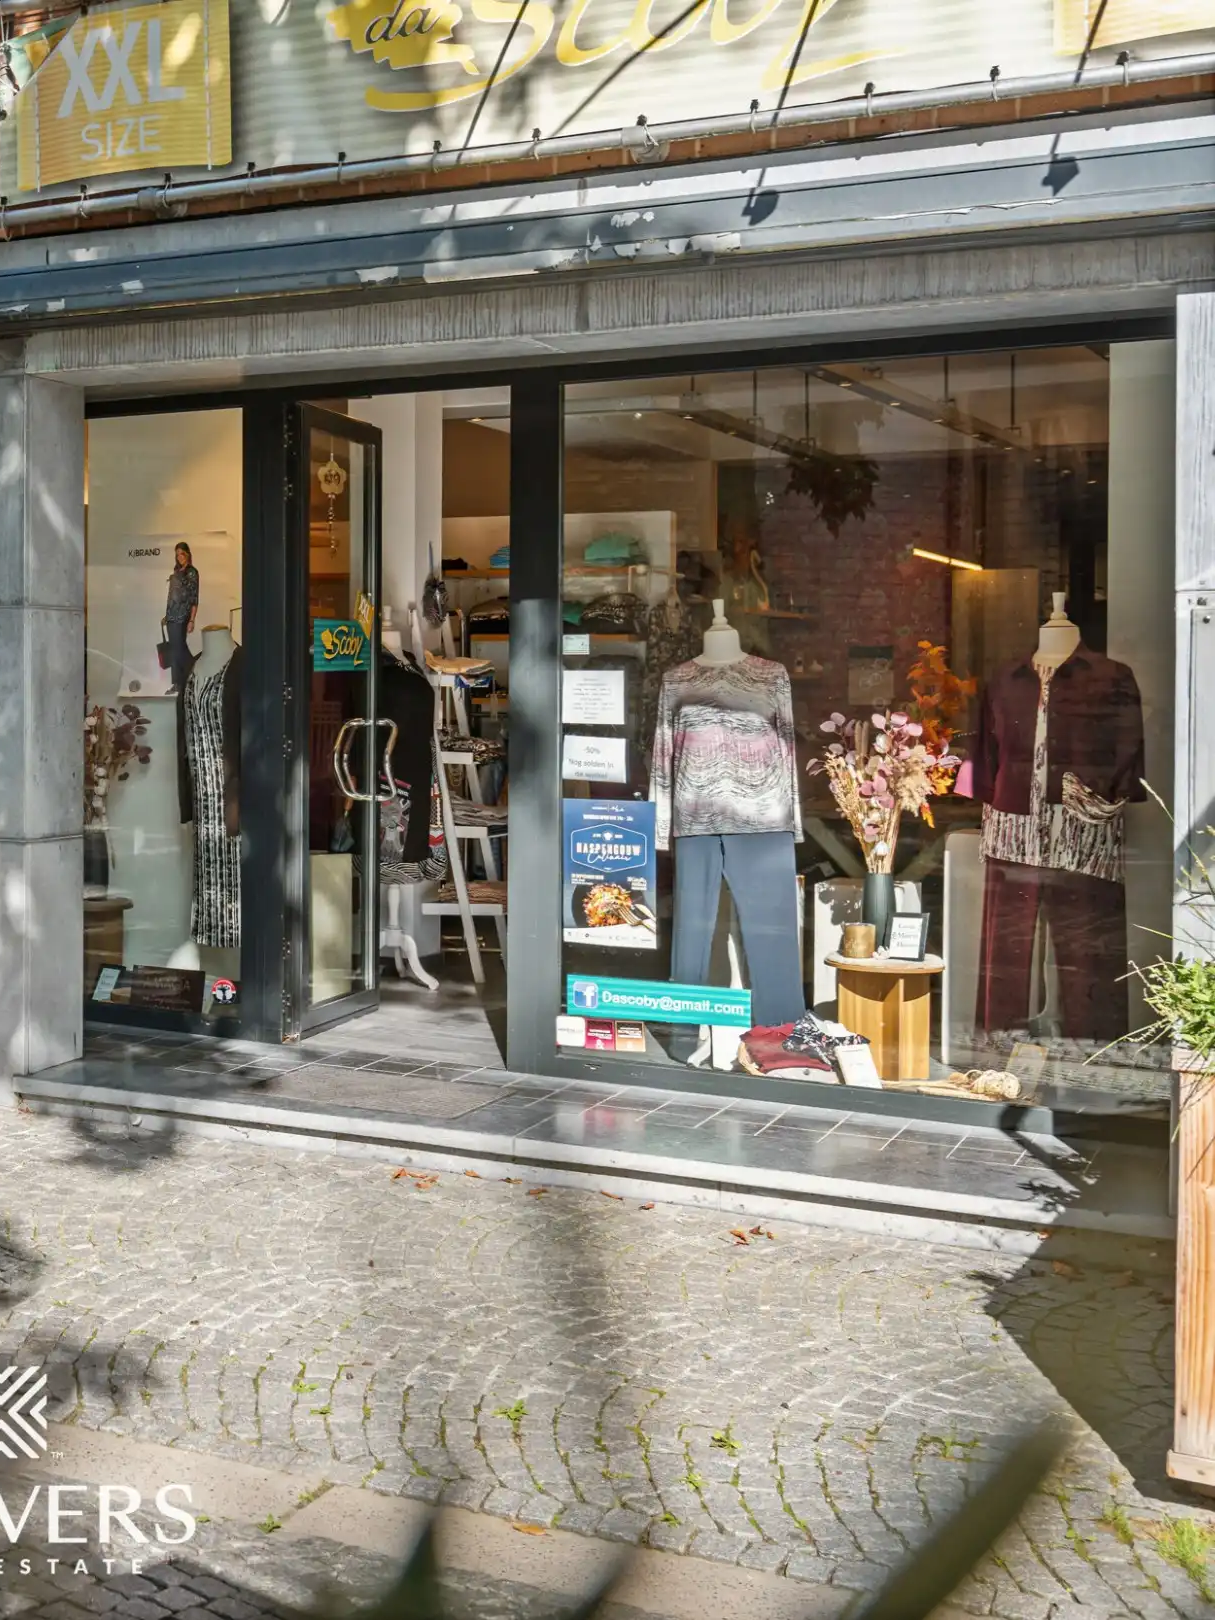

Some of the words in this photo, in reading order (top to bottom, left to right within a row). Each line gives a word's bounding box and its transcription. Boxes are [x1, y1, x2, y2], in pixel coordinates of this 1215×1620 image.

[56, 18, 186, 119] XXL
[80, 114, 163, 161] SIZE
[601, 990, 745, 1016] Dascoby@gmail.com
